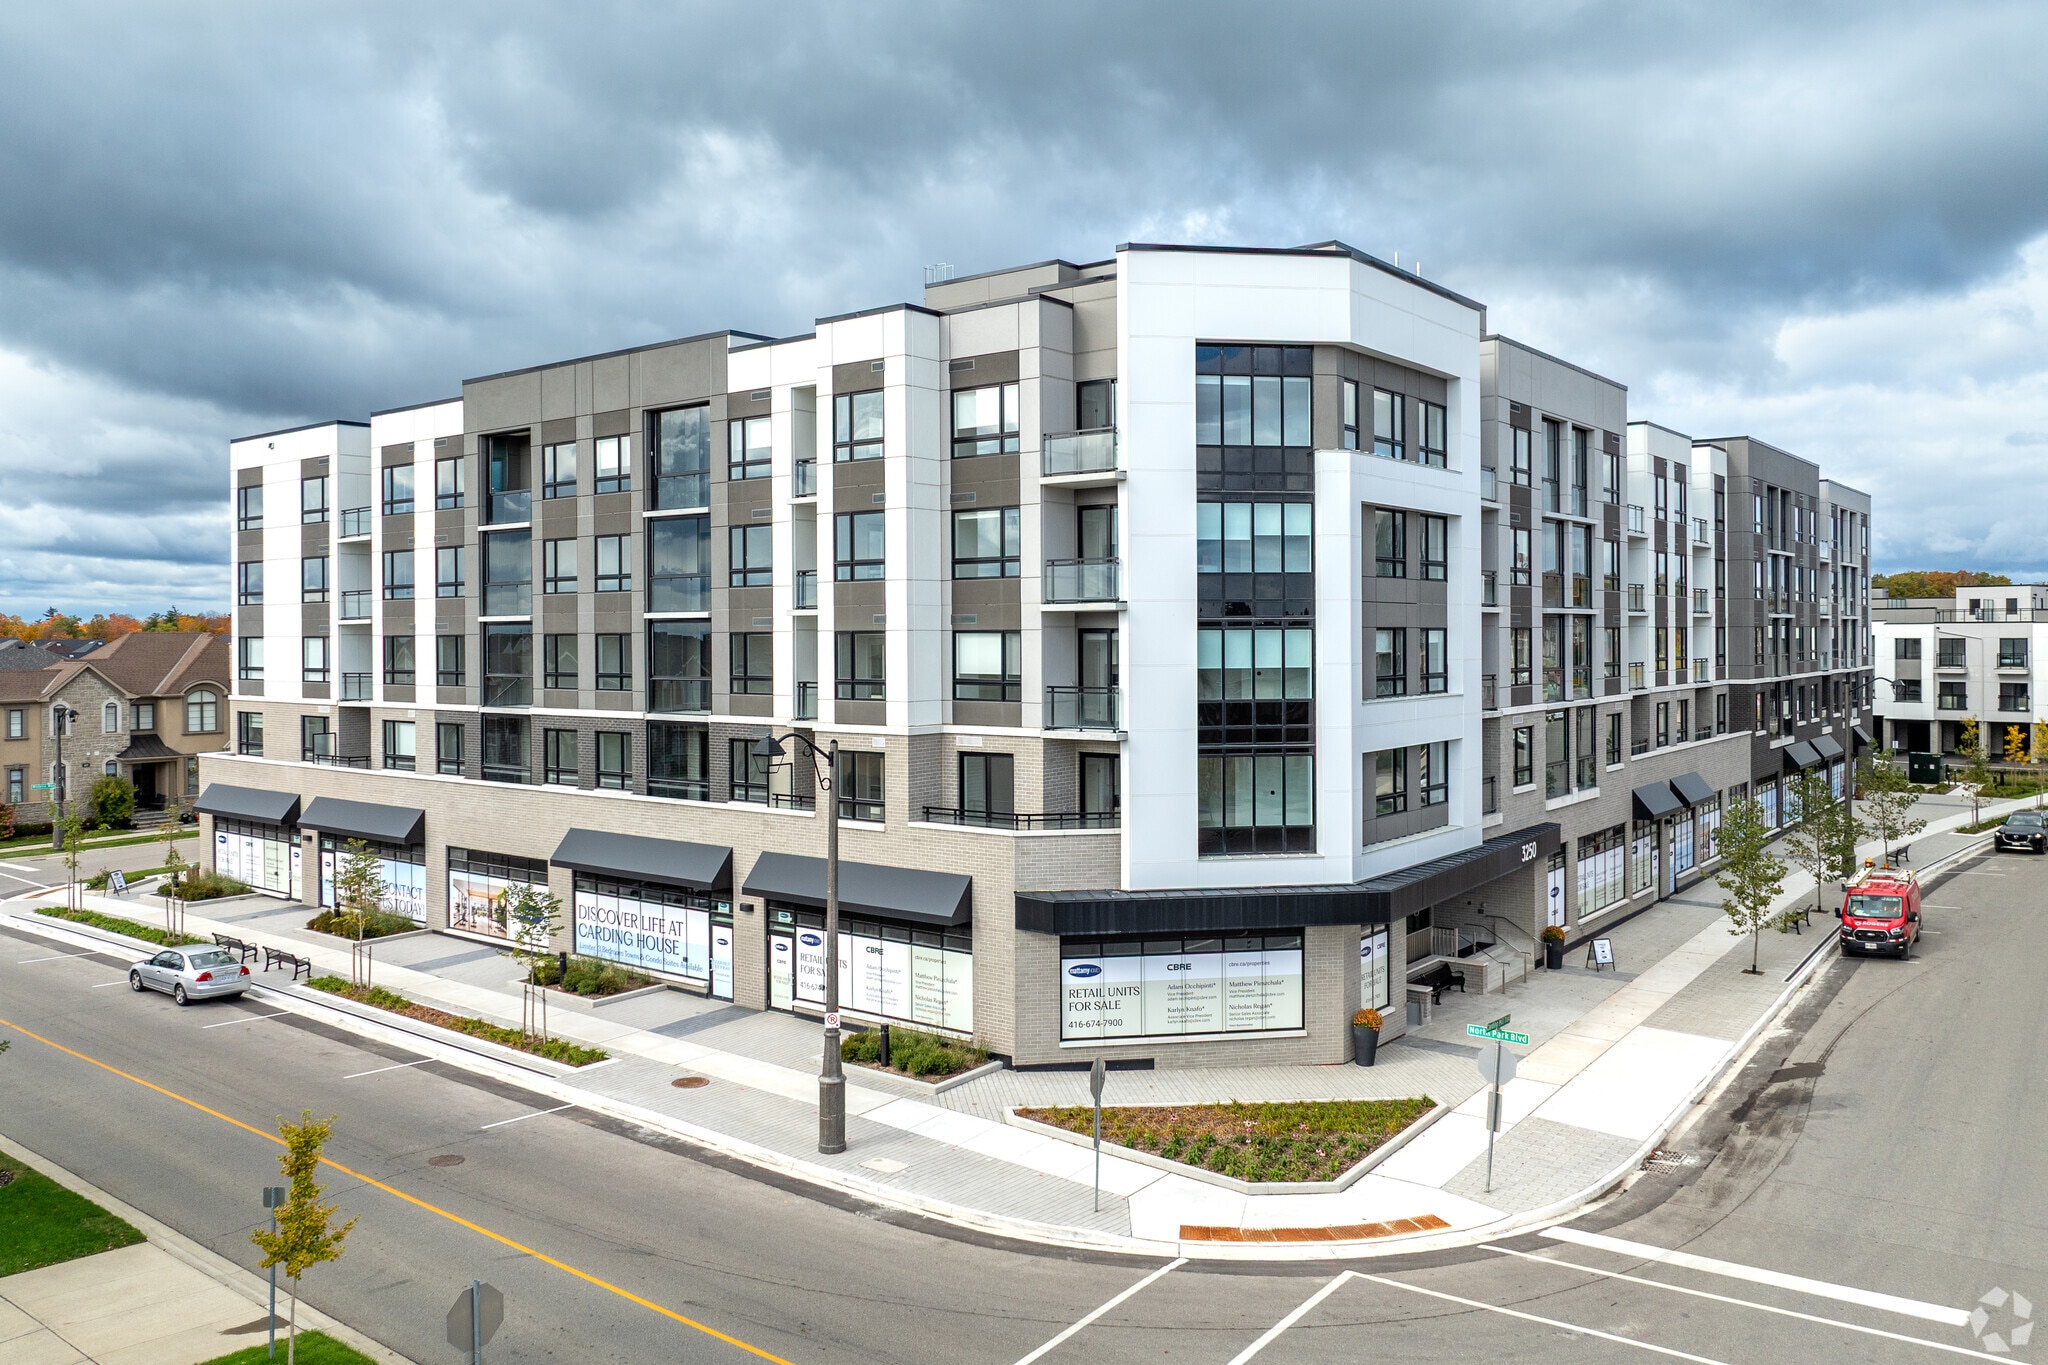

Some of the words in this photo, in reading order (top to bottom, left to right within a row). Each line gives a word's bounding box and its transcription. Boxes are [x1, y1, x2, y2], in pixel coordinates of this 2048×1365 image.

[1521, 841, 1537, 862] 3250
[394, 899, 425, 917] TODAY!
[578, 904, 638, 929] DISCOVER
[641, 915, 666, 934] LIFE
[668, 920, 684, 937] AT
[578, 922, 634, 946] CARDING
[636, 932, 680, 955] HOUSE
[800, 952, 823, 965] RETAIL
[800, 964, 815, 975] FOR
[1166, 963, 1192, 971] CBRE
[1068, 988, 1105, 999] RETAIL
[1107, 986, 1141, 997] UNITS
[1068, 1001, 1091, 1012] FOR
[1094, 1000, 1121, 1011] SALE
[1068, 1018, 1123, 1029] 416-674-7900
[1492, 1030, 1509, 1040] Park
[1510, 1033, 1527, 1043] Blvd
